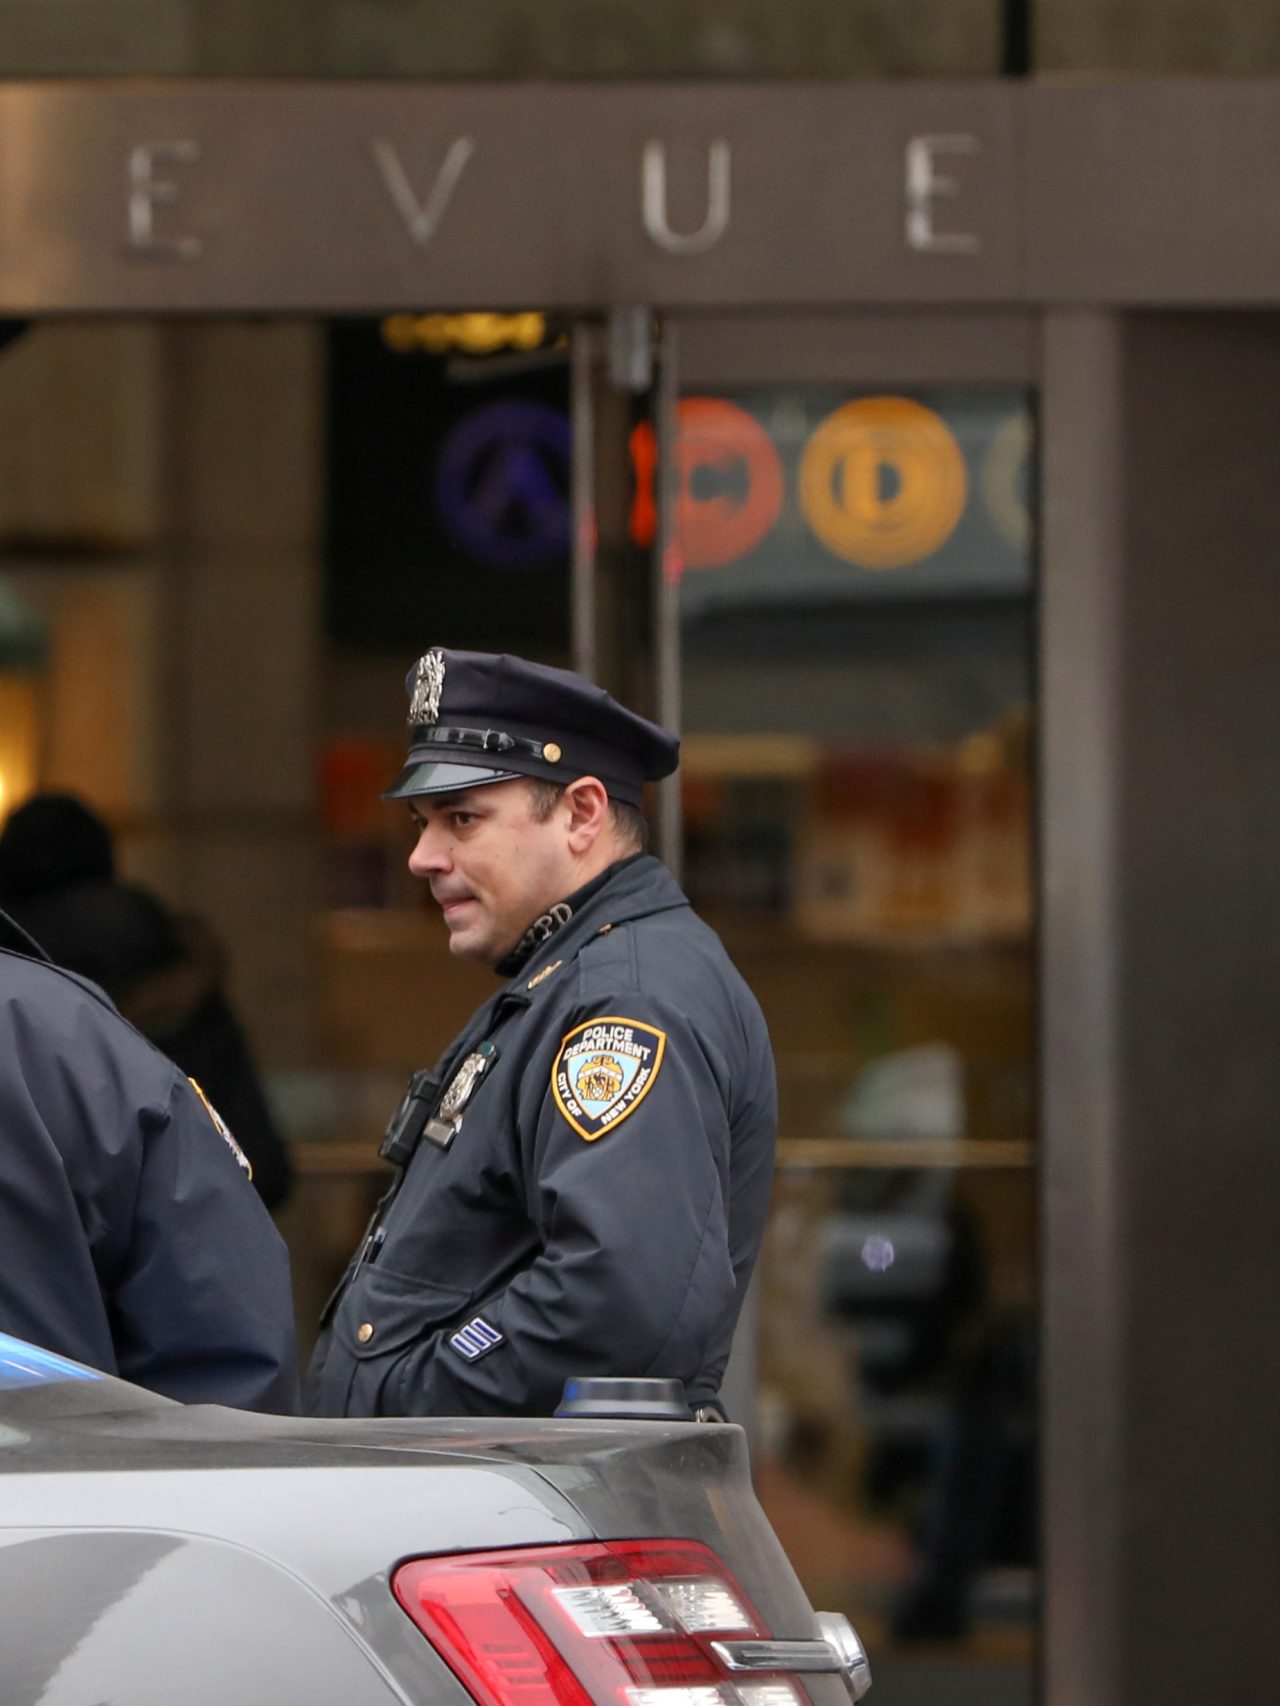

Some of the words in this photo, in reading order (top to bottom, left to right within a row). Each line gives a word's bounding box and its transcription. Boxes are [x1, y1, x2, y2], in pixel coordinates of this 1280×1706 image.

[563, 1038, 652, 1061] DEPARTMENT
[582, 1025, 634, 1042] POLICE
[557, 1072, 572, 1099] CITY
[566, 1099, 583, 1117] OF
[600, 1099, 628, 1125] NEW
[623, 1067, 652, 1101] YORK
